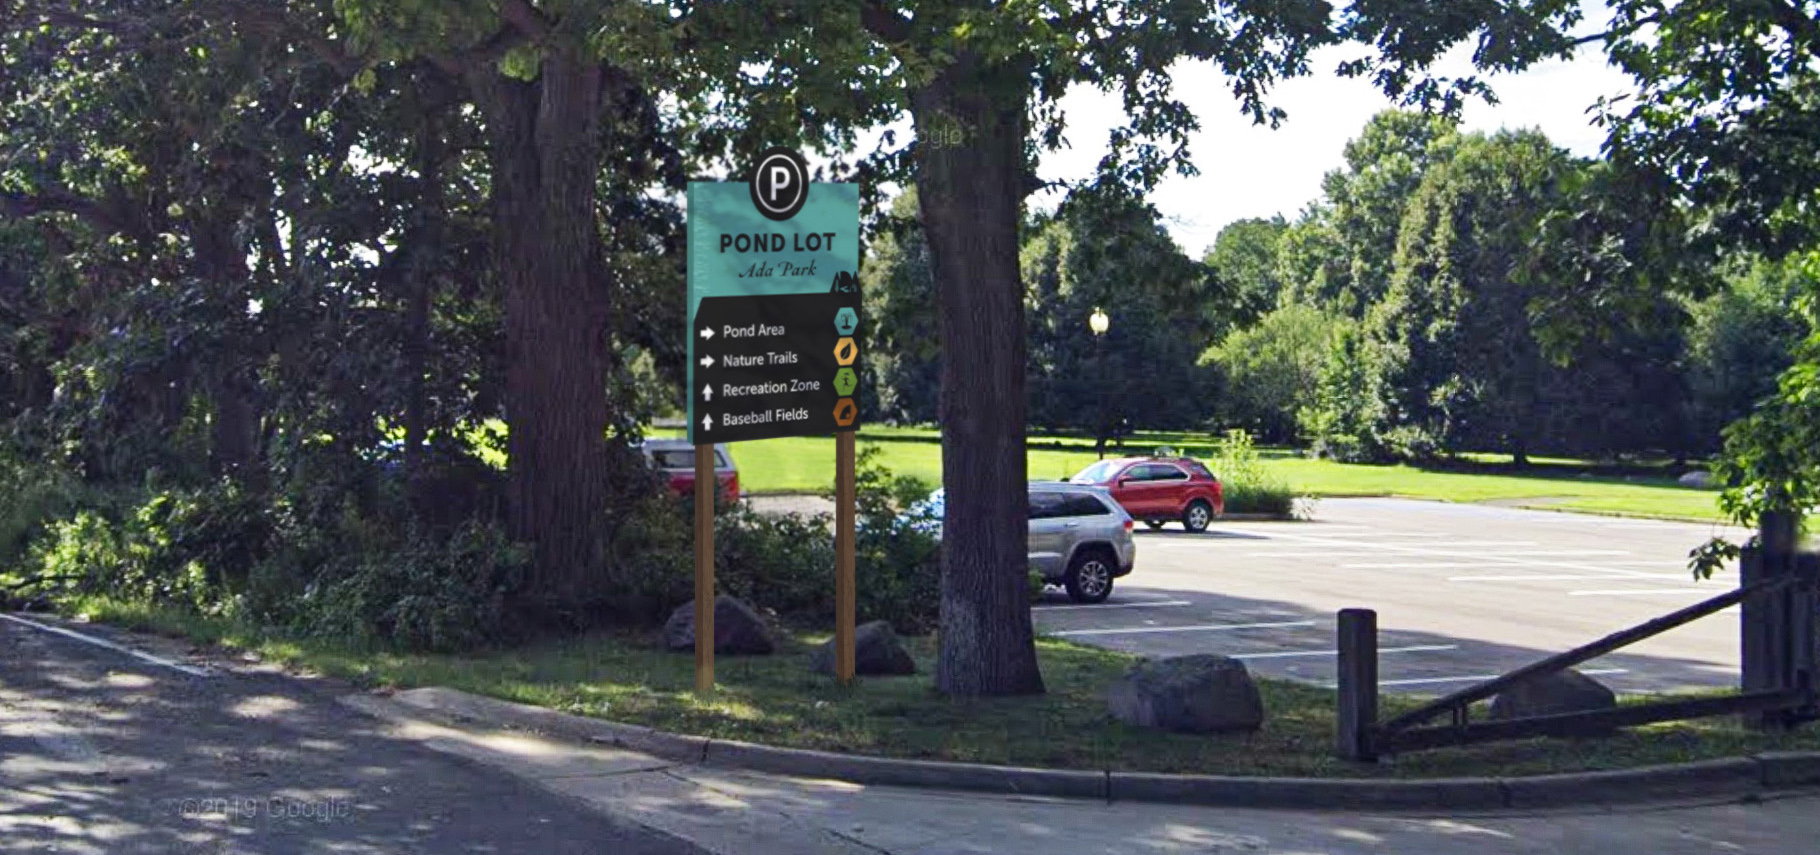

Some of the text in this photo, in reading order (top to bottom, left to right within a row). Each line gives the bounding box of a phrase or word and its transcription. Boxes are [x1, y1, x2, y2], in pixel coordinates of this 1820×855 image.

[770, 166, 791, 201] P
[720, 232, 836, 253] POND LOT
[738, 259, 817, 279] Ada Park
[723, 324, 785, 339] Pond Area
[723, 352, 798, 368] Nature Trails
[723, 379, 820, 398] Recreation Zone
[723, 408, 809, 427] Baseball Fields
